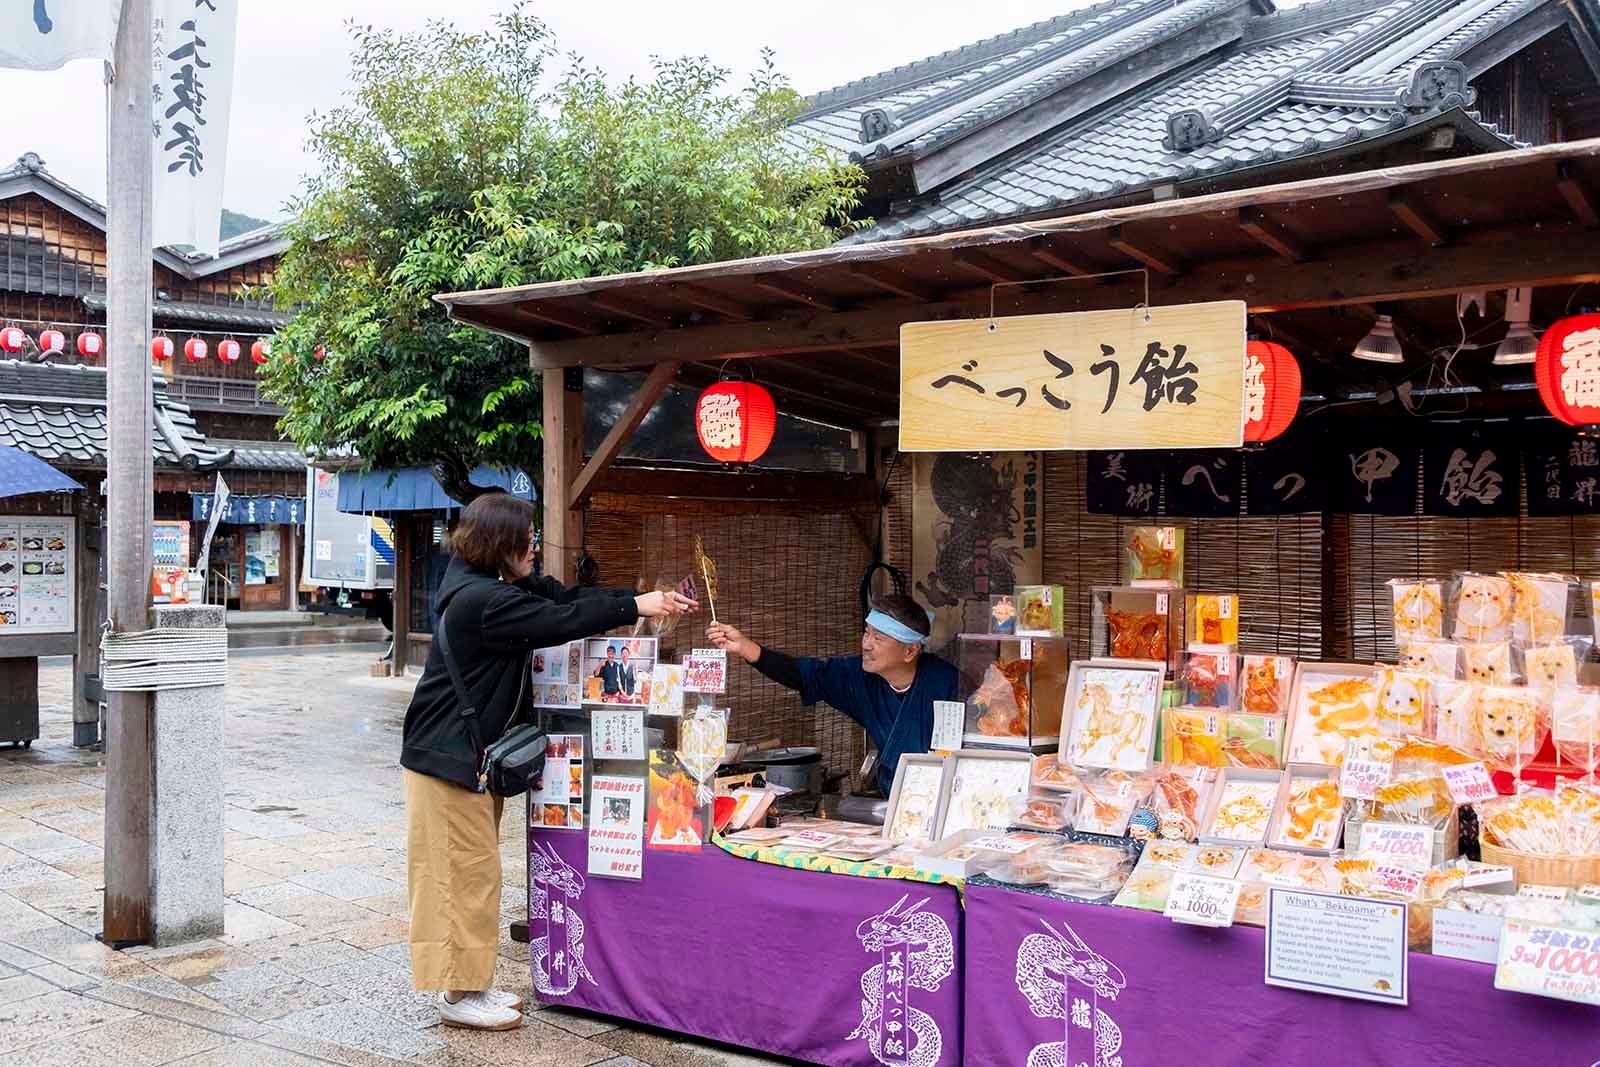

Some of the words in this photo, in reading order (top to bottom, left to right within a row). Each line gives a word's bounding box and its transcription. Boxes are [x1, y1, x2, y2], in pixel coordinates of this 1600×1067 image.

[931, 341, 1200, 414] べっこう飴
[1285, 895, 1318, 908] What's
[883, 950, 905, 1056] 美術べっ甲飴
[1069, 997, 1093, 1067] 龍
